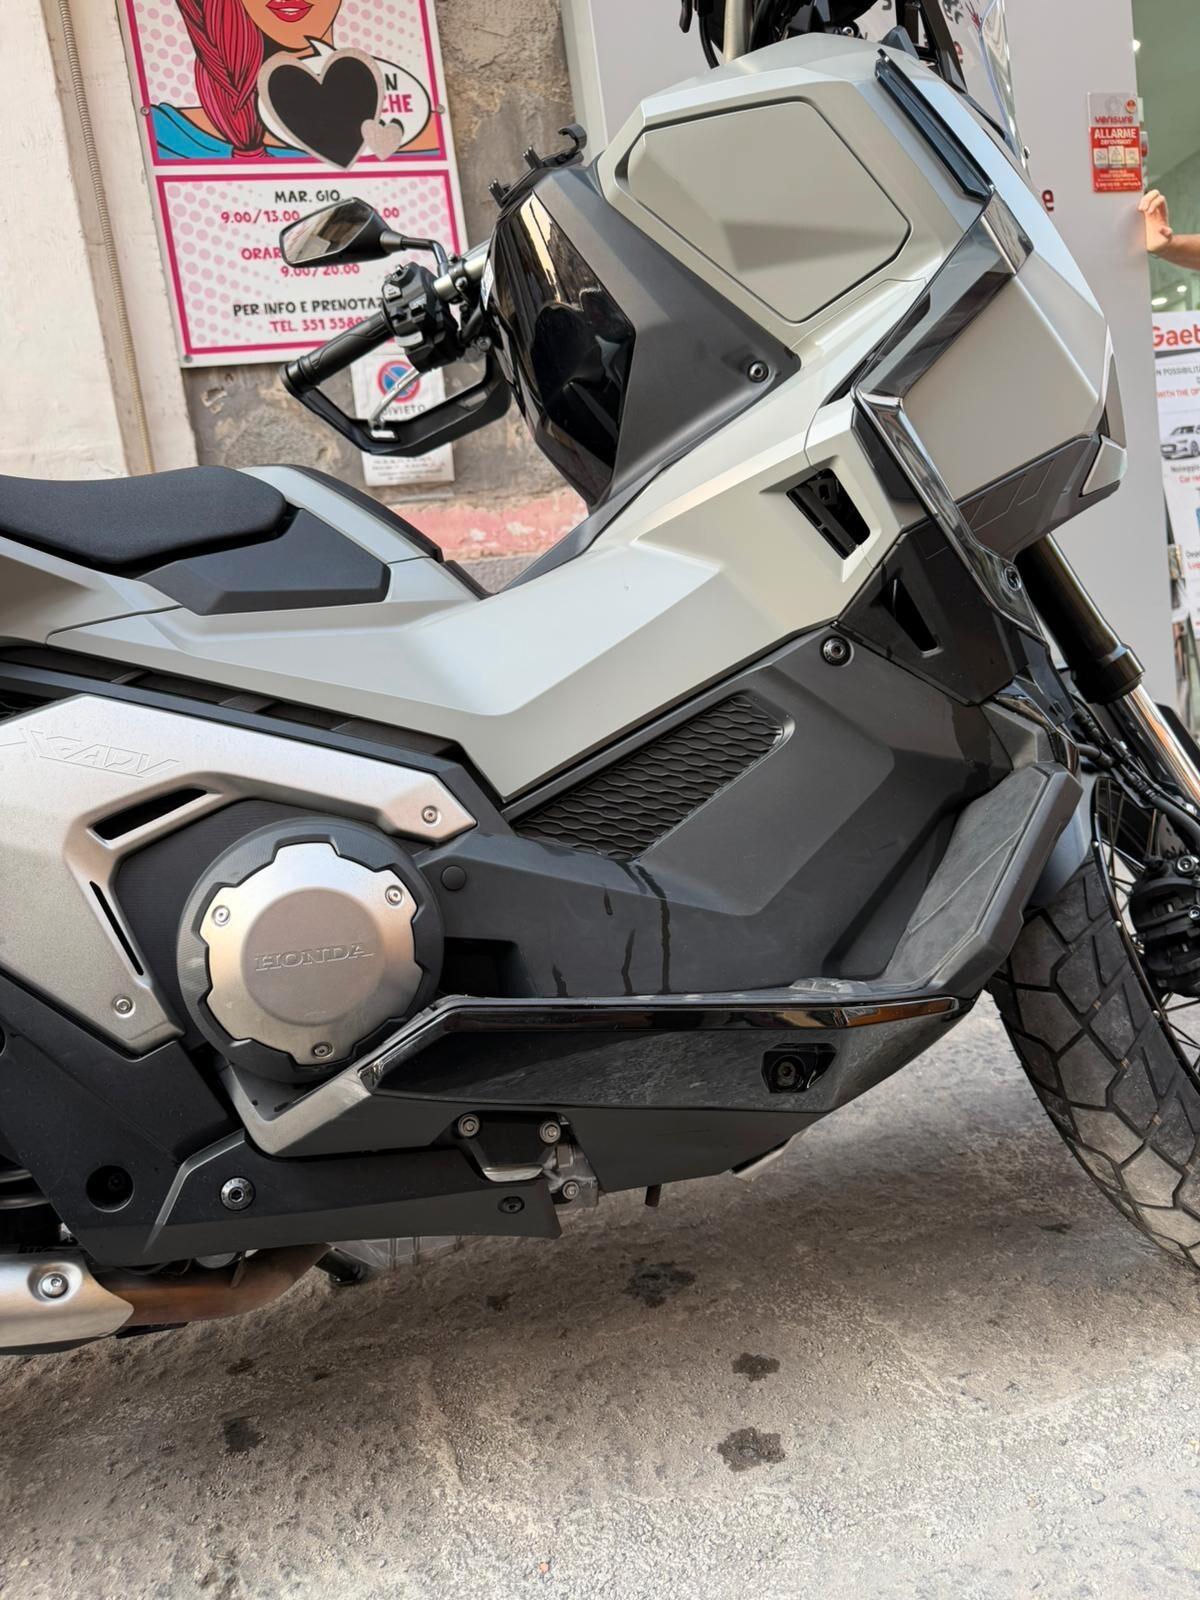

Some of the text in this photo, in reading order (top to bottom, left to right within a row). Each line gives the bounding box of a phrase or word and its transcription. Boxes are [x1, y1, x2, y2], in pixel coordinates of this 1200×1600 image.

[1094, 115, 1134, 124] verisure
[1094, 128, 1137, 139] ALLARME
[275, 190, 312, 204] MAR.
[220, 209, 300, 224] 9.00/13.00
[233, 304, 259, 317] PER
[264, 302, 296, 315] INFO
[301, 301, 308, 313] E
[302, 318, 325, 331] 351
[254, 943, 375, 972] HONDA
